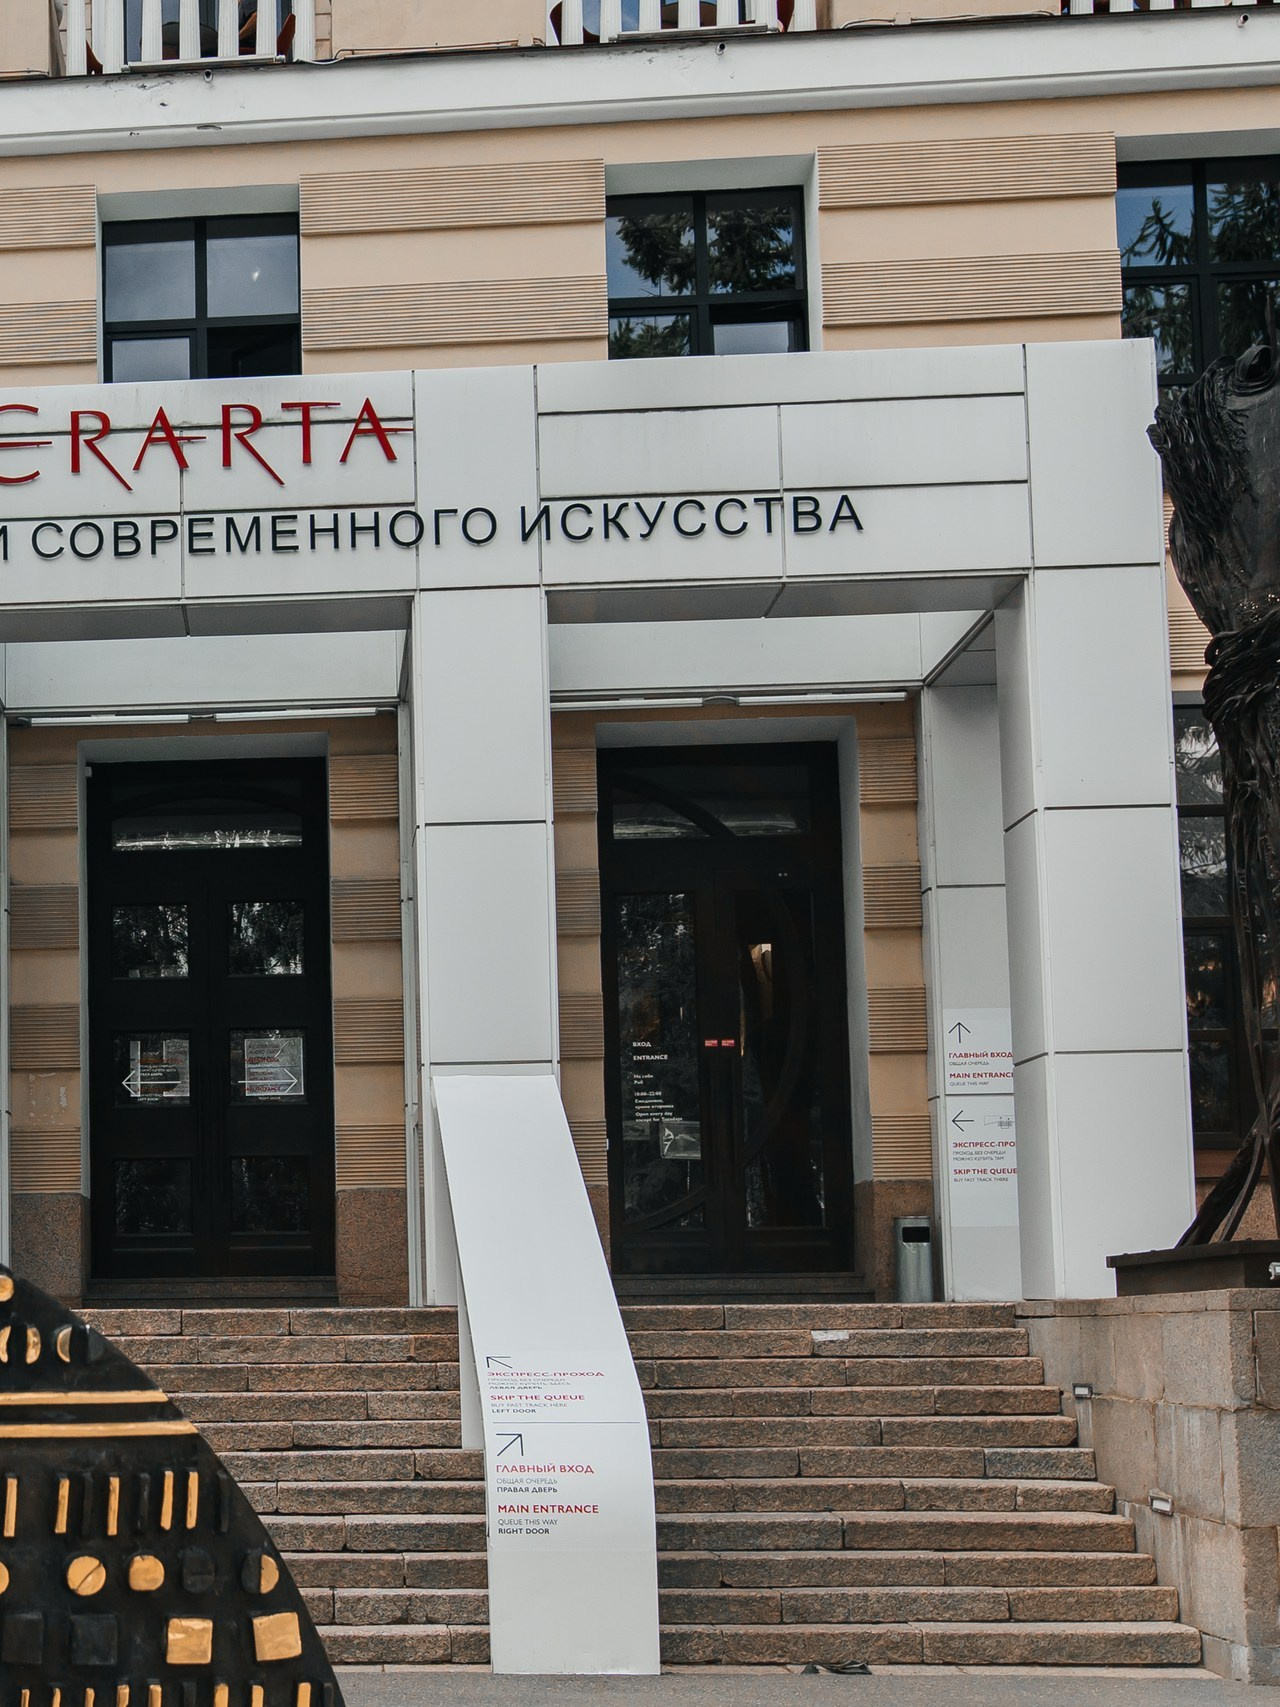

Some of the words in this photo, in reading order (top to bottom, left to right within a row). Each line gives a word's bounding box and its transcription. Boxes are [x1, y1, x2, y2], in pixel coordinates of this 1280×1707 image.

[31, 507, 498, 559] СОВРЕМЕННОГО
[520, 494, 864, 542] ИСКУССТВА
[496, 1463, 556, 1473] ГЛАВНЫЙ
[560, 1465, 594, 1474] ВХОД
[498, 1505, 529, 1513] MAIN
[533, 1505, 599, 1513] ENTRANCE
